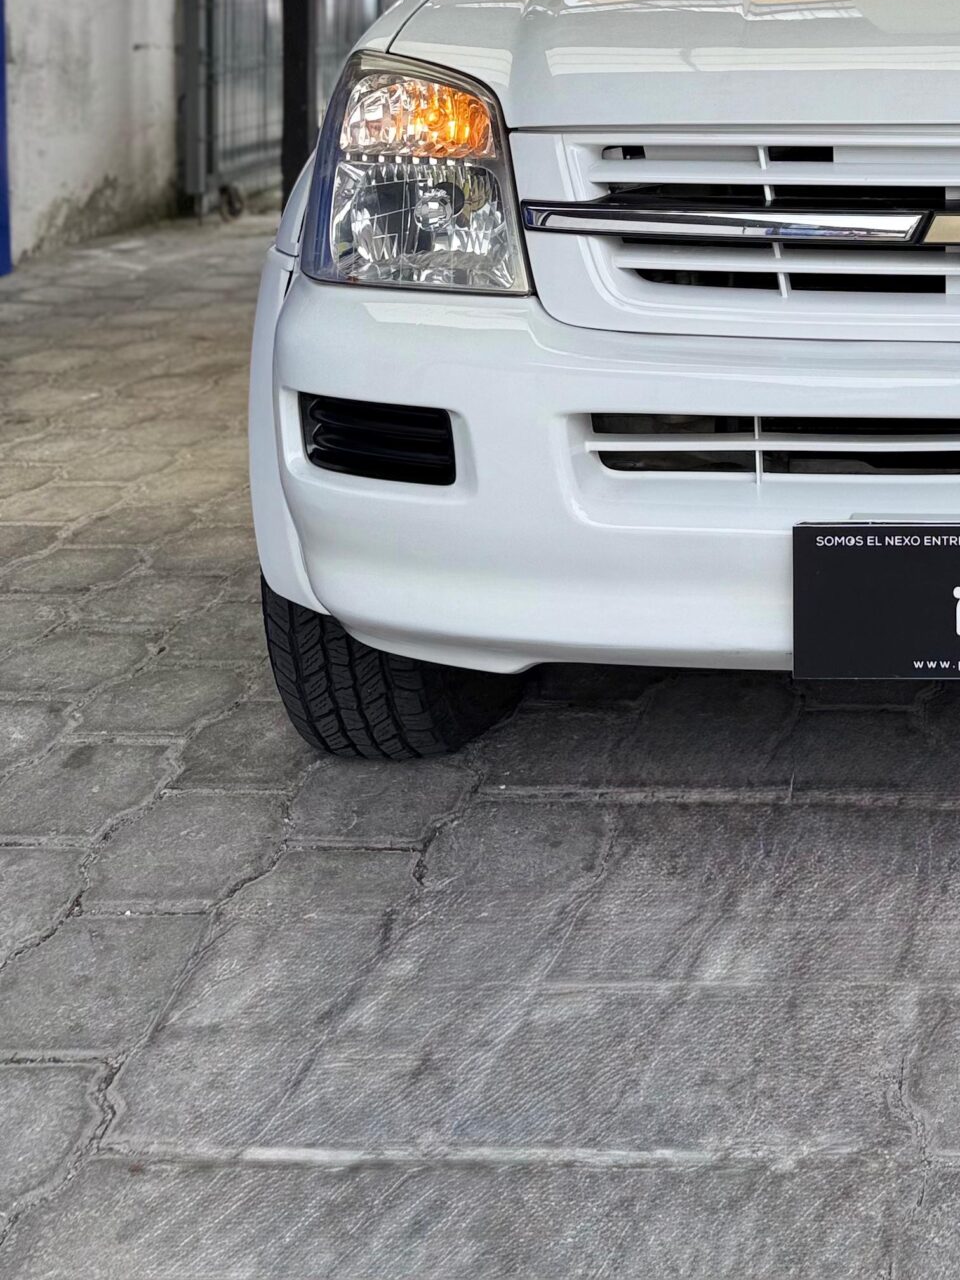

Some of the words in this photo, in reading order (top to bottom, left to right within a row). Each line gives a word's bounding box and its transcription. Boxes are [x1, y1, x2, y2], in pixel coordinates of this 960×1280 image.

[816, 535, 864, 547] SOMOS
[866, 535, 883, 546] EL
[885, 535, 921, 547] NEXO
